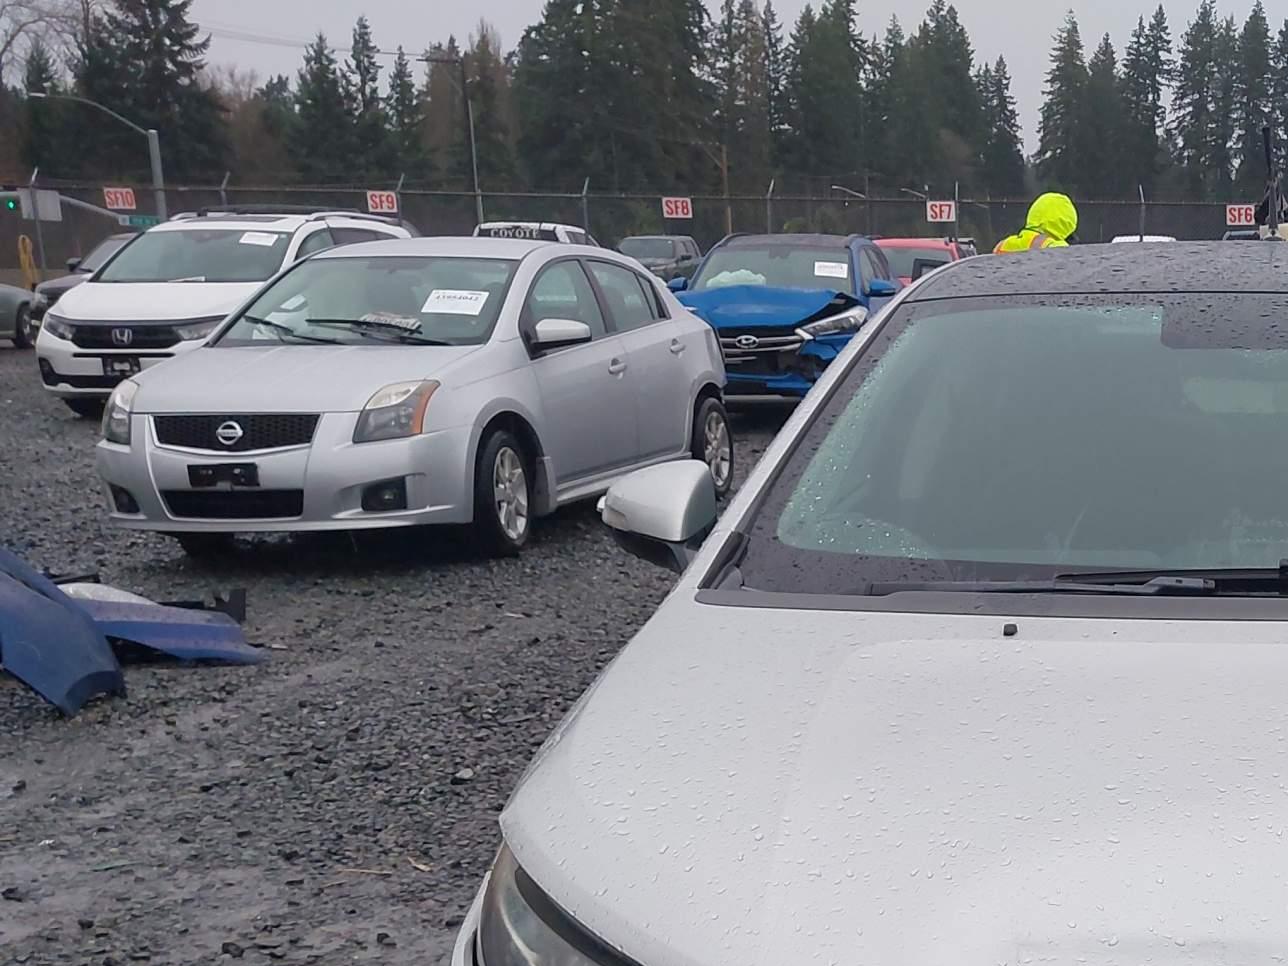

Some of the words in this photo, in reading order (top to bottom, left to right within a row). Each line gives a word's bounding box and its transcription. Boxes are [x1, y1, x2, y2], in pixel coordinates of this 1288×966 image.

[106, 191, 133, 208] SF10
[370, 193, 395, 210] SF9
[665, 199, 689, 216] SF8
[930, 203, 952, 220] SF7
[1228, 207, 1253, 223] SF6
[490, 228, 540, 239] COYOTE
